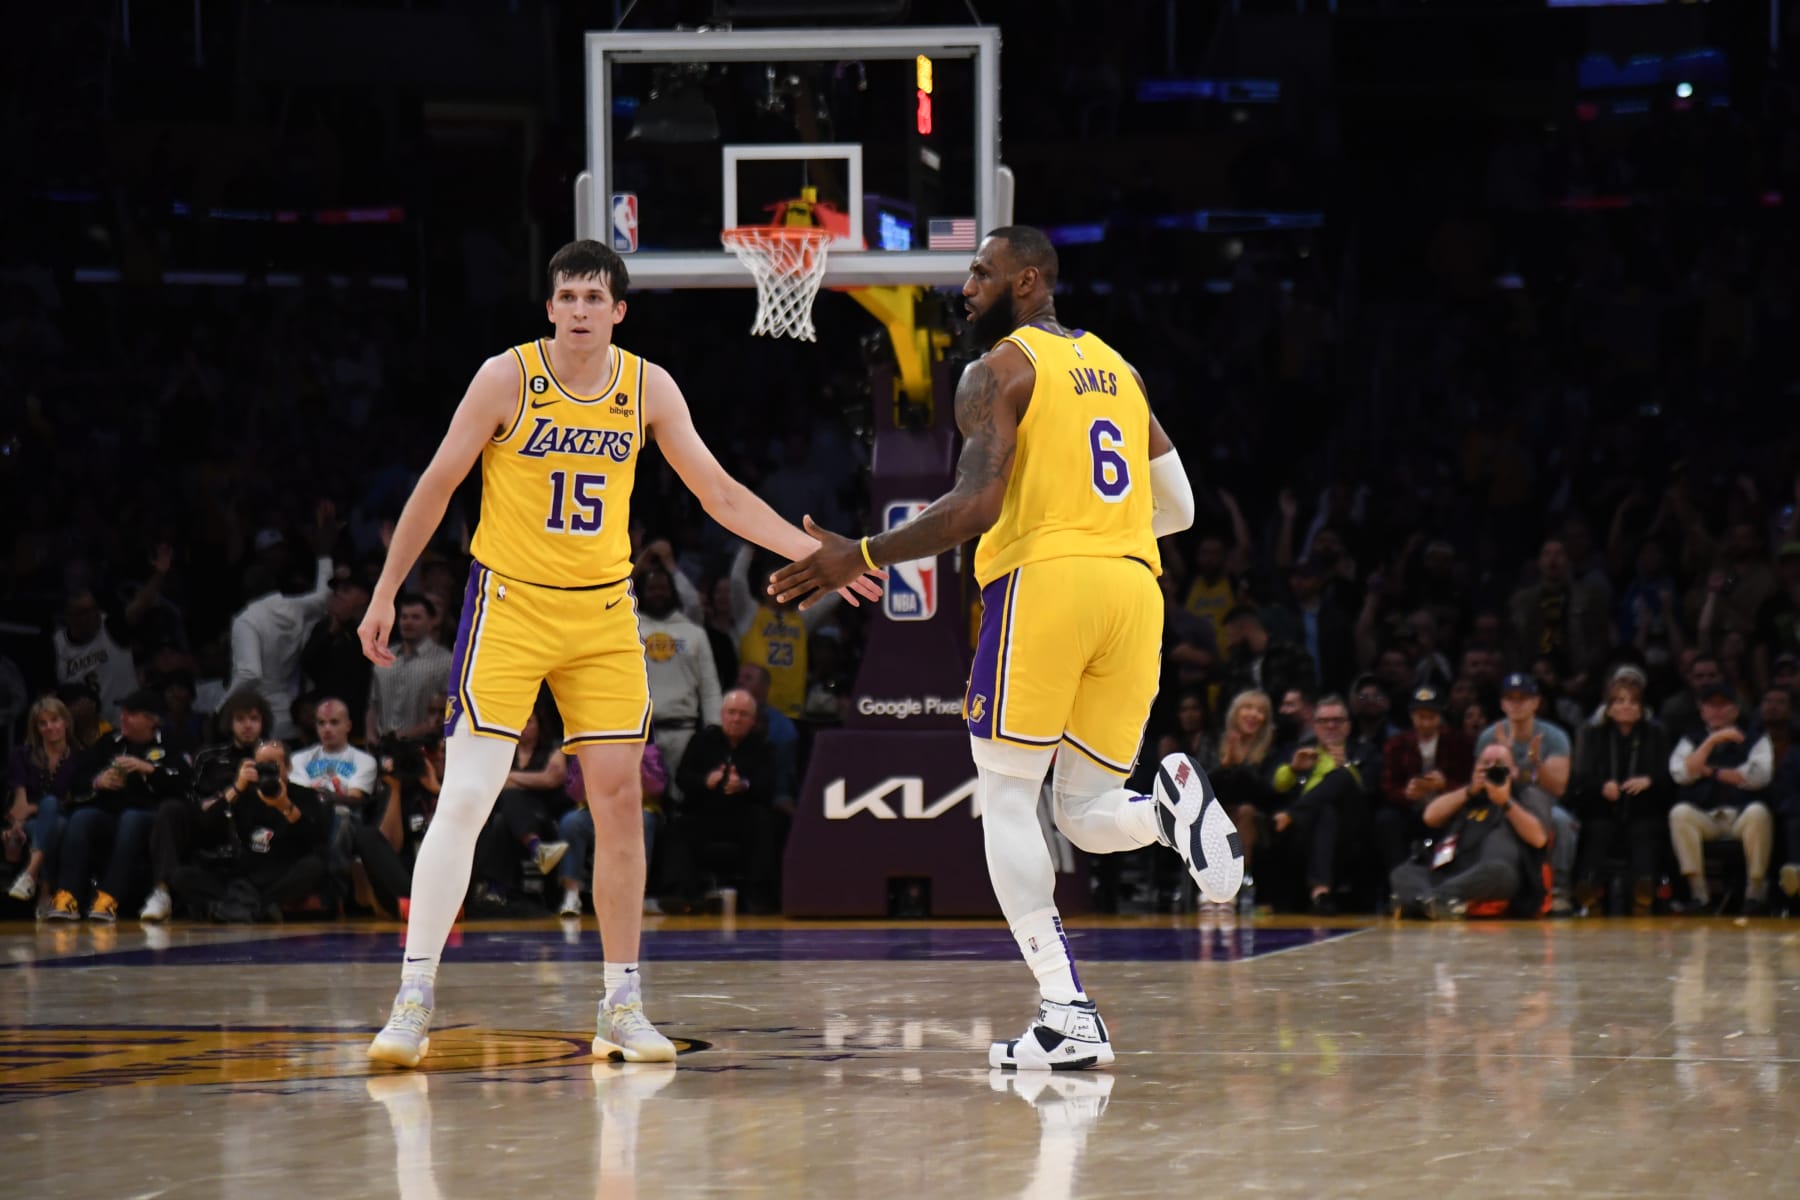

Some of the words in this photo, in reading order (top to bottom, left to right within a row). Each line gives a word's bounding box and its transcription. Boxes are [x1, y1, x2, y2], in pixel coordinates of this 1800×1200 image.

[533, 377, 546, 393] 6
[1068, 367, 1118, 397] JAMES
[609, 406, 634, 417] bibigo
[517, 417, 634, 463] LAKERS
[1089, 417, 1133, 503] 6
[545, 470, 608, 536] 15
[766, 640, 795, 667] 23
[857, 697, 922, 720] Google
